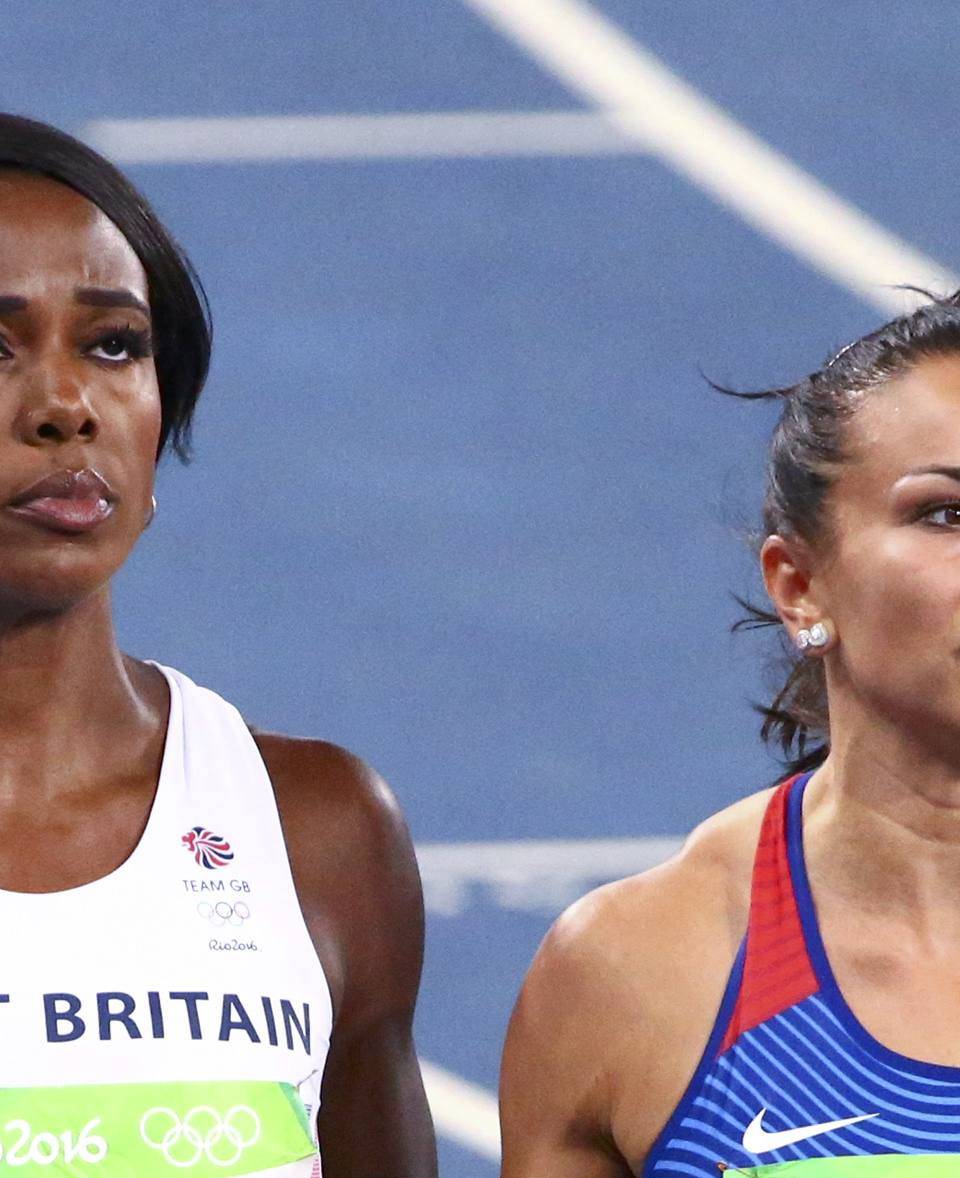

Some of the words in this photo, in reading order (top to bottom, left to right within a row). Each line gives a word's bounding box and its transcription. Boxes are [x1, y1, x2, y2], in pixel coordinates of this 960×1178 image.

[183, 879, 225, 893] TEAM
[229, 879, 251, 893] GB
[43, 991, 312, 1056] BRITAIN
